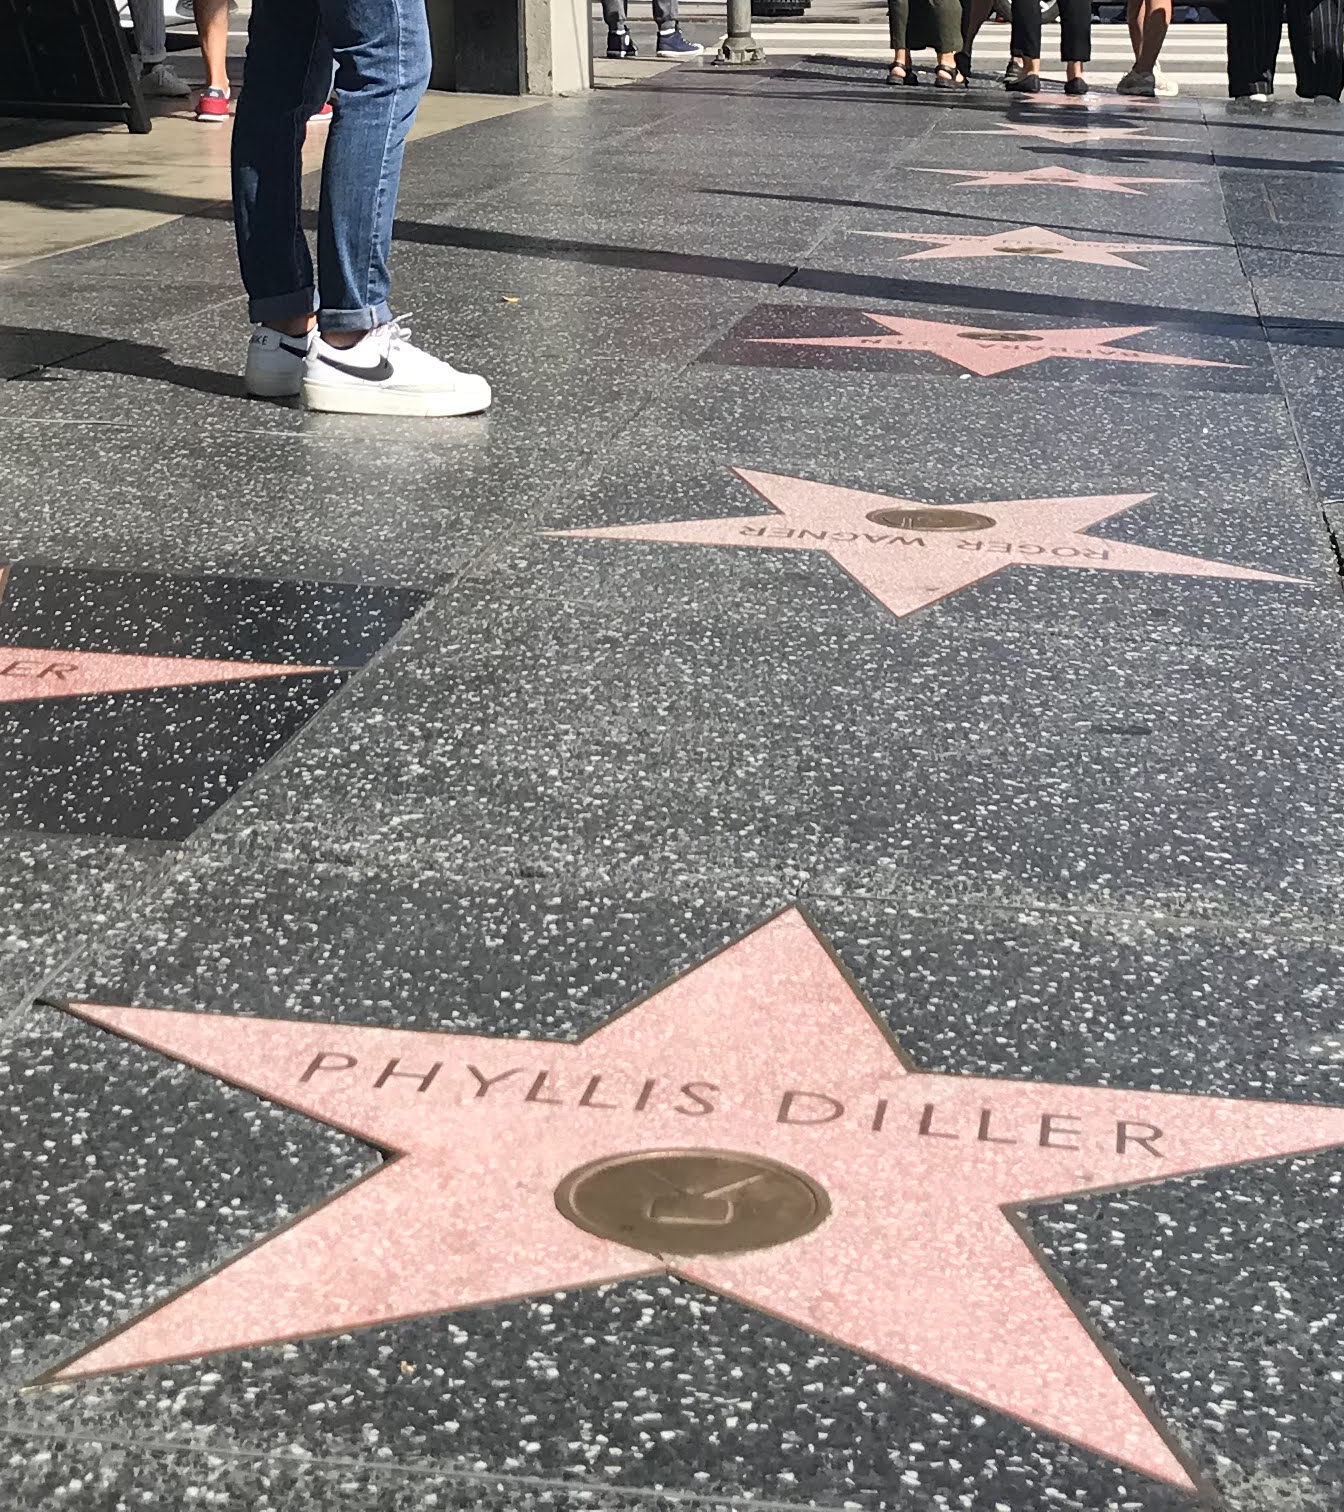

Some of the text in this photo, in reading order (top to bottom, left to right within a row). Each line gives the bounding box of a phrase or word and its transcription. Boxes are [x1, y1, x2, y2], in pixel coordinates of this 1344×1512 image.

[739, 525, 1109, 561] ROGER WAGNER
[298, 1051, 1165, 1159] PHYLLIS DILLER
